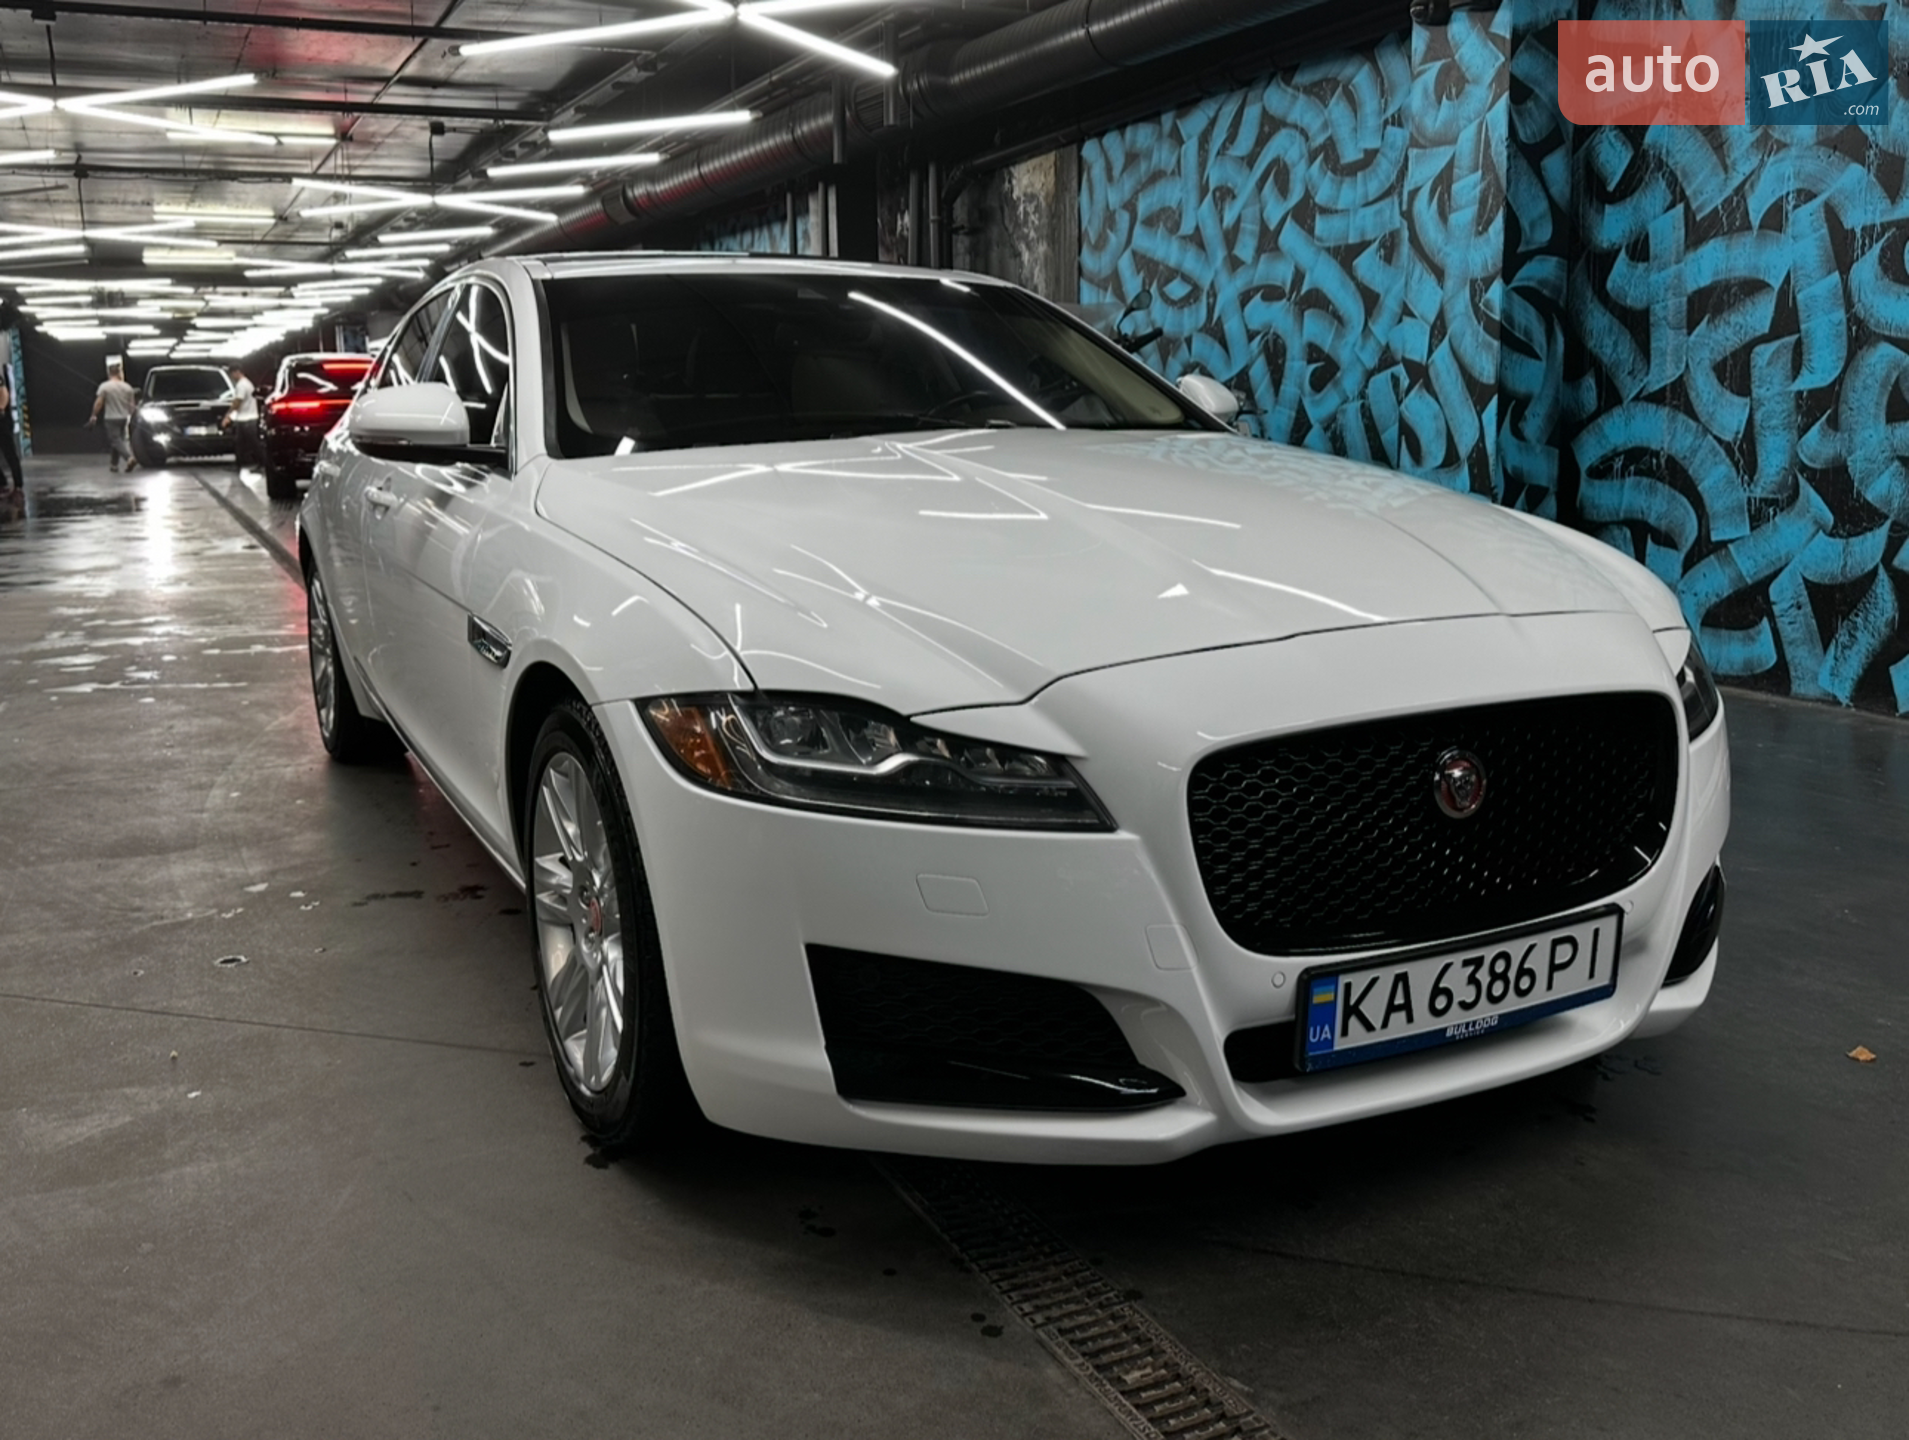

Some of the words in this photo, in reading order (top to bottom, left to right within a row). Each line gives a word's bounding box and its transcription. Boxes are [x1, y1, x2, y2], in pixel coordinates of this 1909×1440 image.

[1340, 970, 1414, 1038] KA
[1428, 942, 1537, 1018] 6386
[1546, 926, 1600, 992] PI
[1309, 1024, 1332, 1043] UA
[1446, 1015, 1499, 1037] BULLDOG
